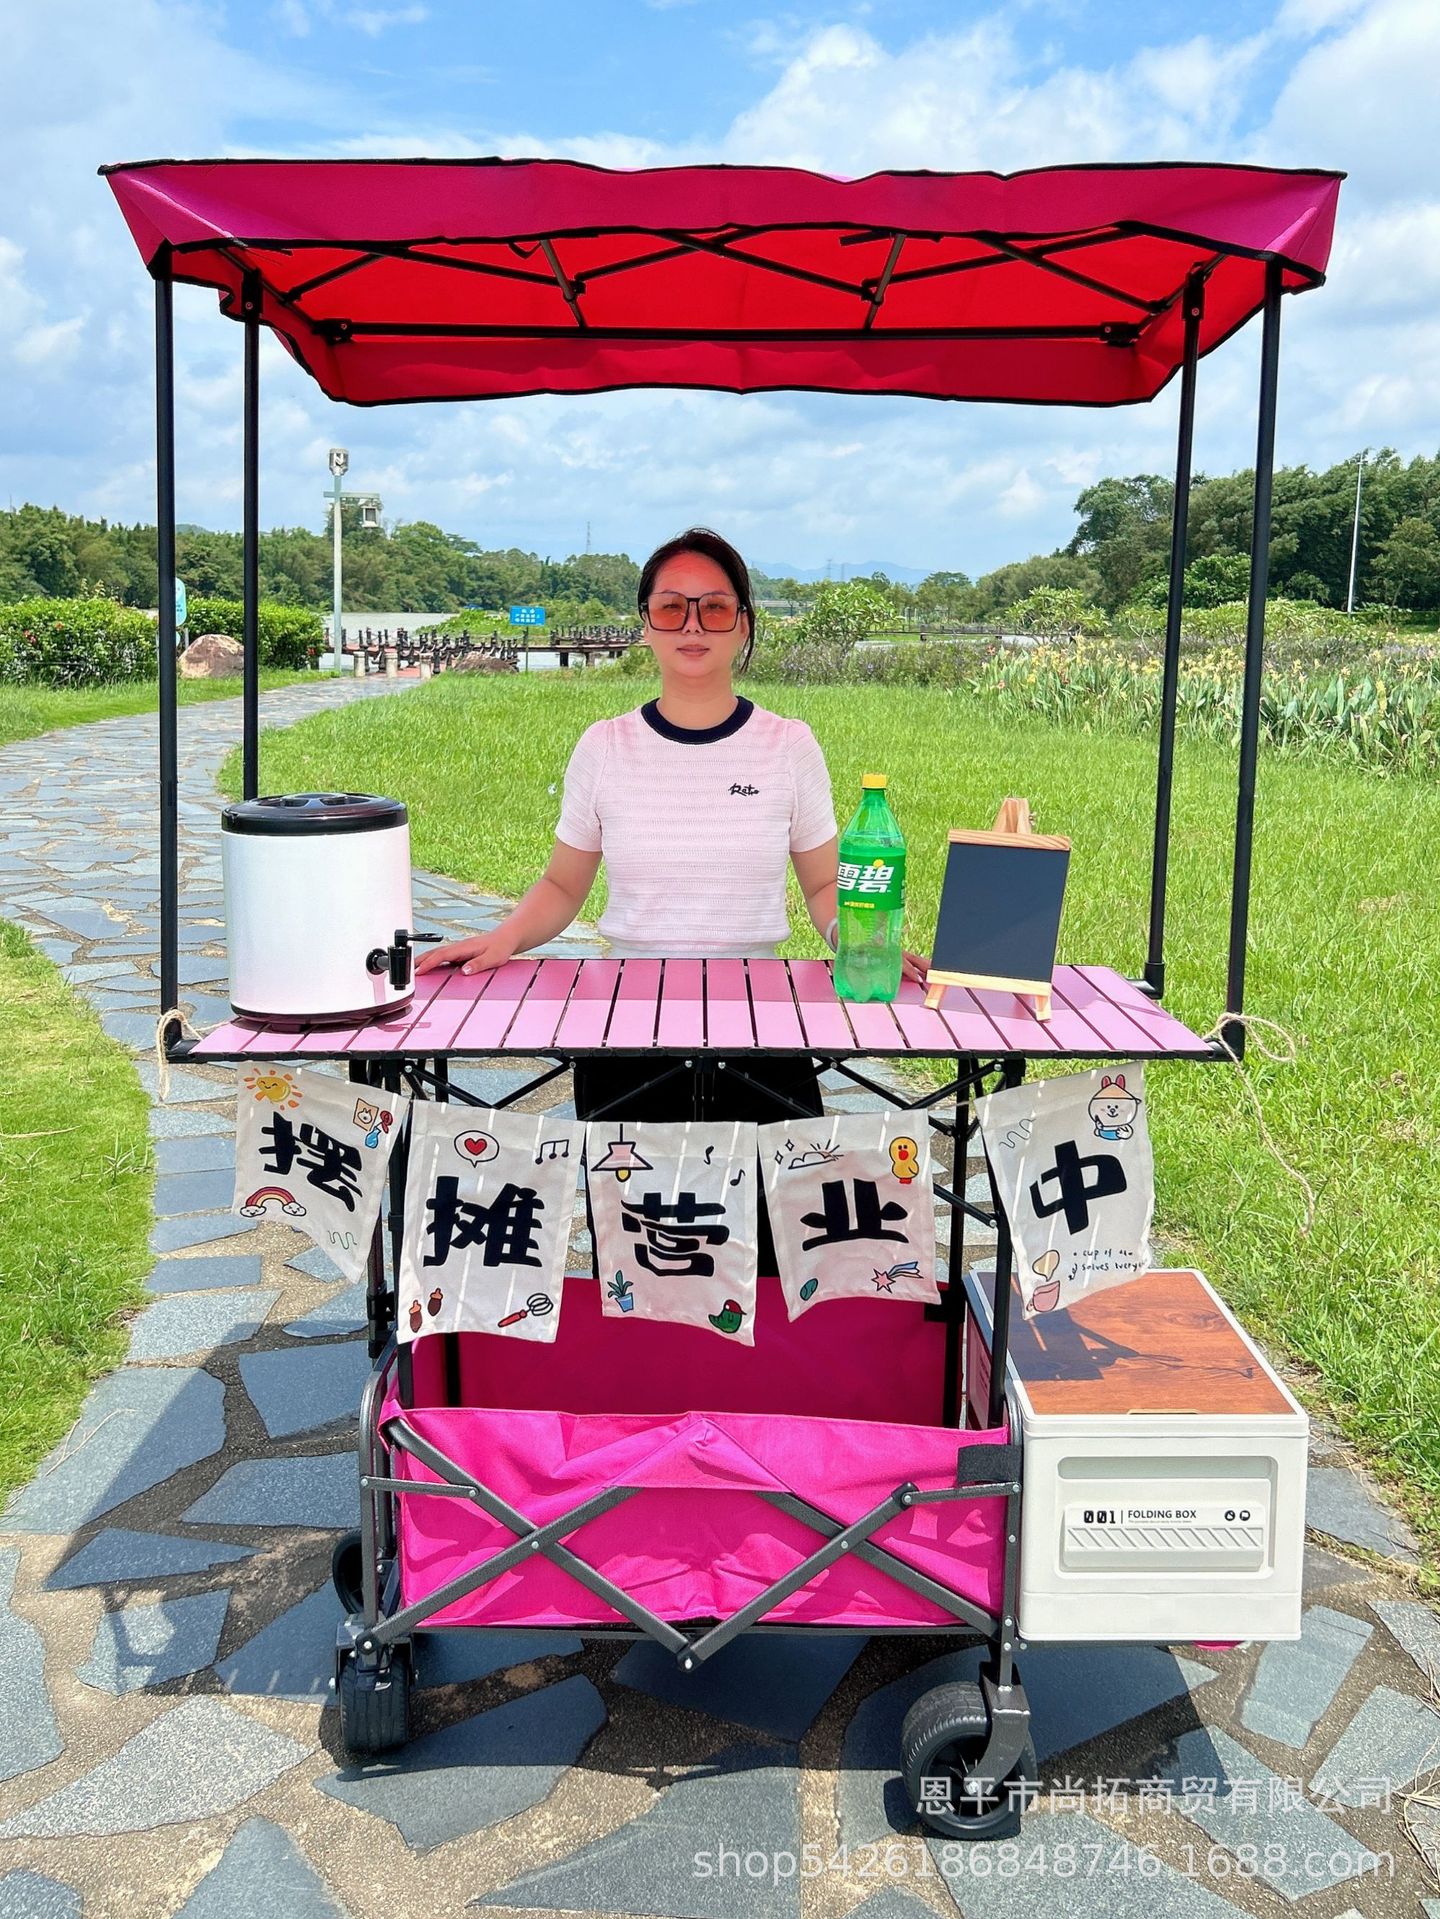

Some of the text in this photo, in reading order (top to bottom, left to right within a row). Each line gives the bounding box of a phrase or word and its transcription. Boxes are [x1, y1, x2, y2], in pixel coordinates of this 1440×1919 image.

[837, 860, 894, 893] 雪碧
[1083, 1510, 1116, 1524] 001
[1127, 1509, 1197, 1519] FOLDING BOX
